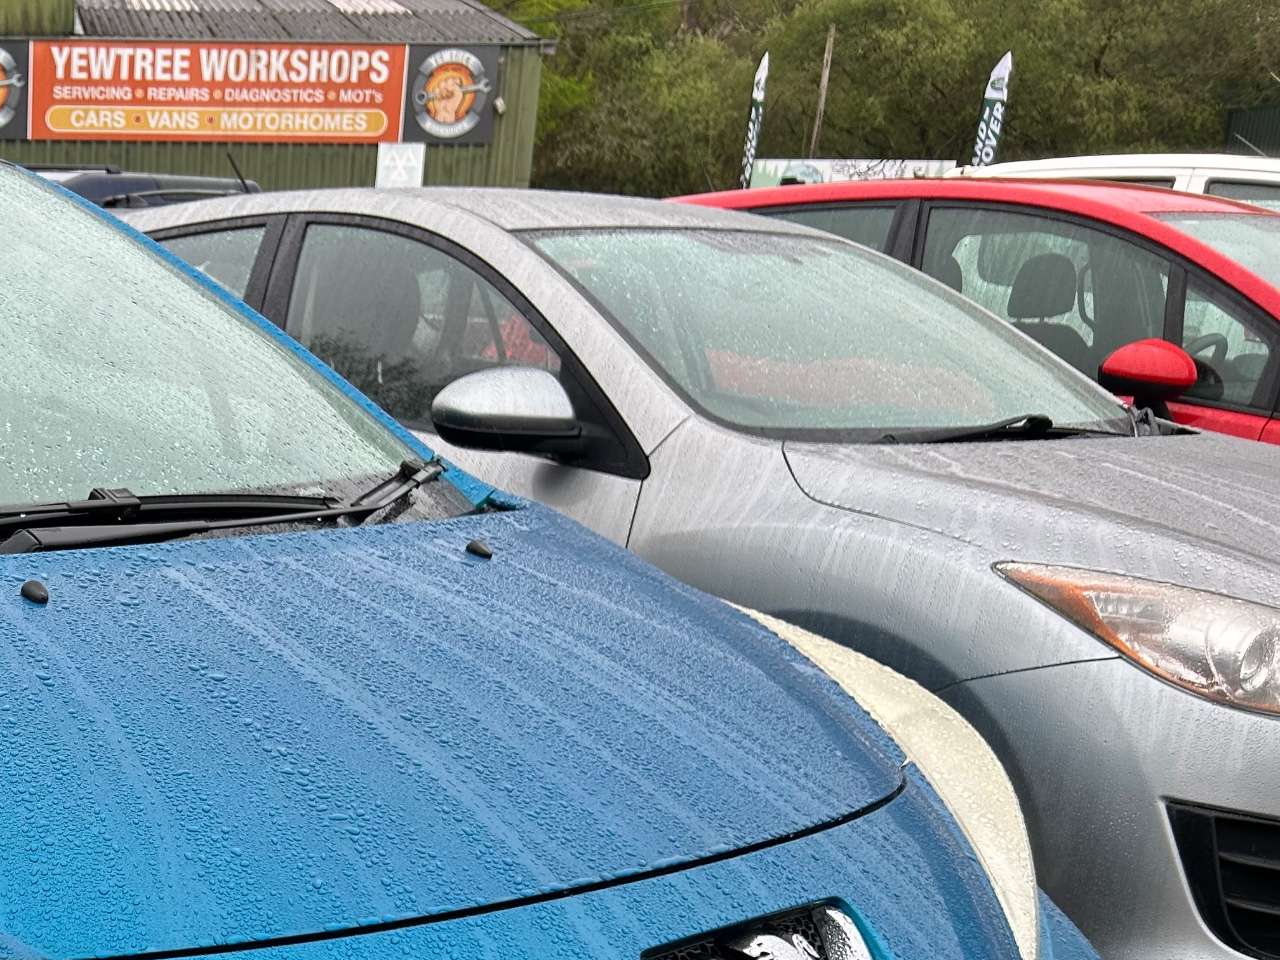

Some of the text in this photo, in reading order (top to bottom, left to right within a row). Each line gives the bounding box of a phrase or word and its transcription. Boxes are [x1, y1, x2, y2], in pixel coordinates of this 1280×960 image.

[50, 46, 390, 84] YEWTREE WORKSHOPS
[53, 85, 383, 104] SERVICING REPAIRS DIAGNOSTICS MOT's
[70, 110, 368, 131] CARS VANS MOTORHOMES
[981, 101, 1005, 167] OVER
